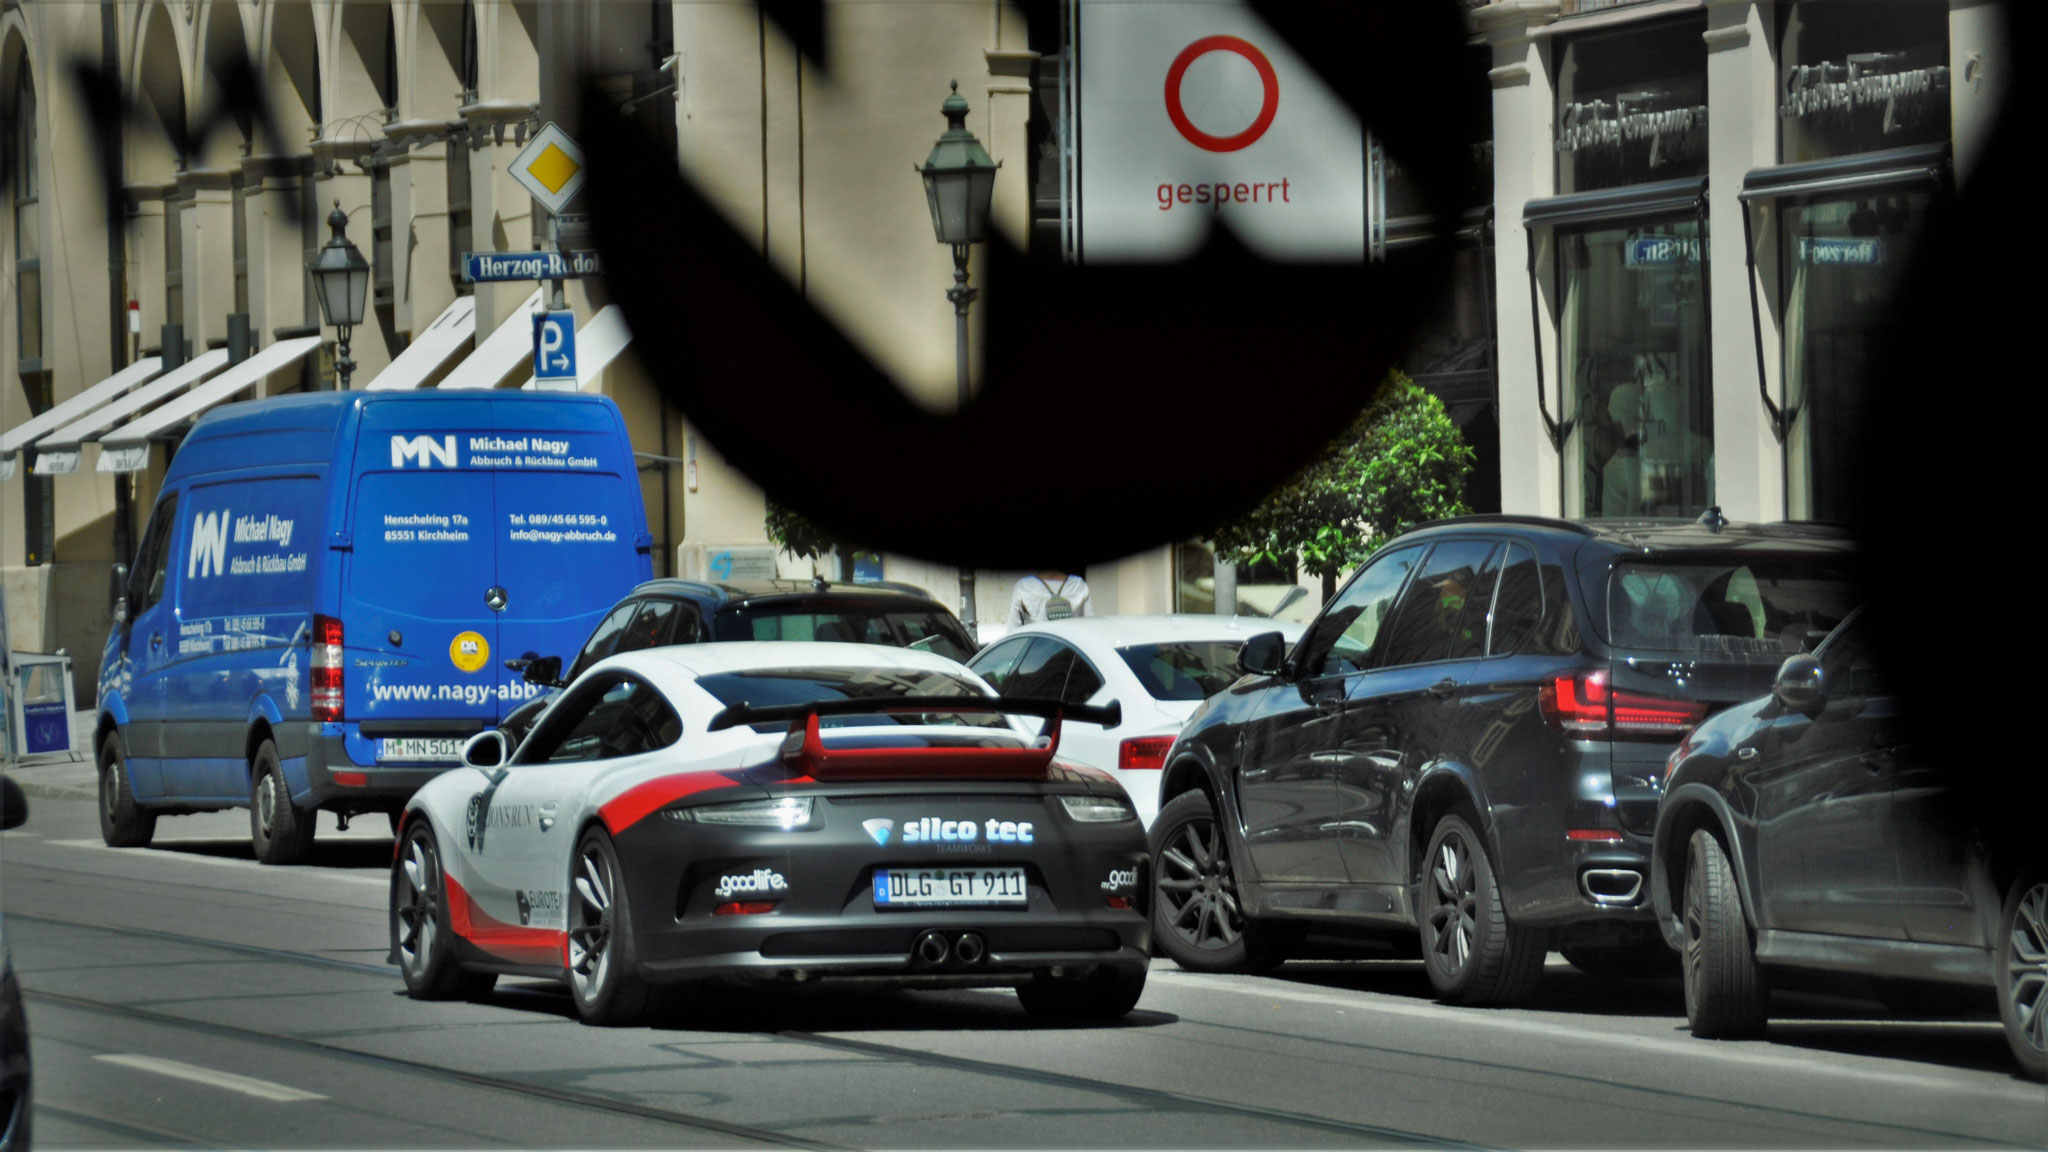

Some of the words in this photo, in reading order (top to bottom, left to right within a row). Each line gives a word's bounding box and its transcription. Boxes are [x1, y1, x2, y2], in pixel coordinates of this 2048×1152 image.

[1157, 177, 1290, 212] gesperrt
[479, 252, 601, 277] Herzog-Rudol
[540, 320, 562, 371] P
[391, 435, 457, 467] MN
[470, 437, 528, 451] Michael
[531, 438, 569, 454] Nagy
[470, 456, 512, 465] Abbruch
[515, 457, 522, 465] &
[525, 456, 565, 466] Rückbau
[567, 457, 598, 467] GmbH
[234, 514, 269, 542] Michael
[269, 515, 293, 546] Nagy
[384, 514, 449, 526] Henschelring
[452, 515, 468, 524] 17a
[510, 514, 526, 524] Tel.
[384, 531, 415, 541] 85551
[418, 531, 468, 541] Kirchheim
[510, 530, 616, 542] info@nagy-abbruch.de
[230, 555, 255, 574] Abbruch
[373, 680, 543, 705] www.nagy-abb
[386, 741, 395, 754] M
[406, 741, 426, 754] MN
[903, 817, 977, 841] silco
[985, 818, 1033, 842] tec
[890, 872, 931, 896] DLG
[949, 872, 976, 895] GT
[984, 871, 1022, 895] 911
